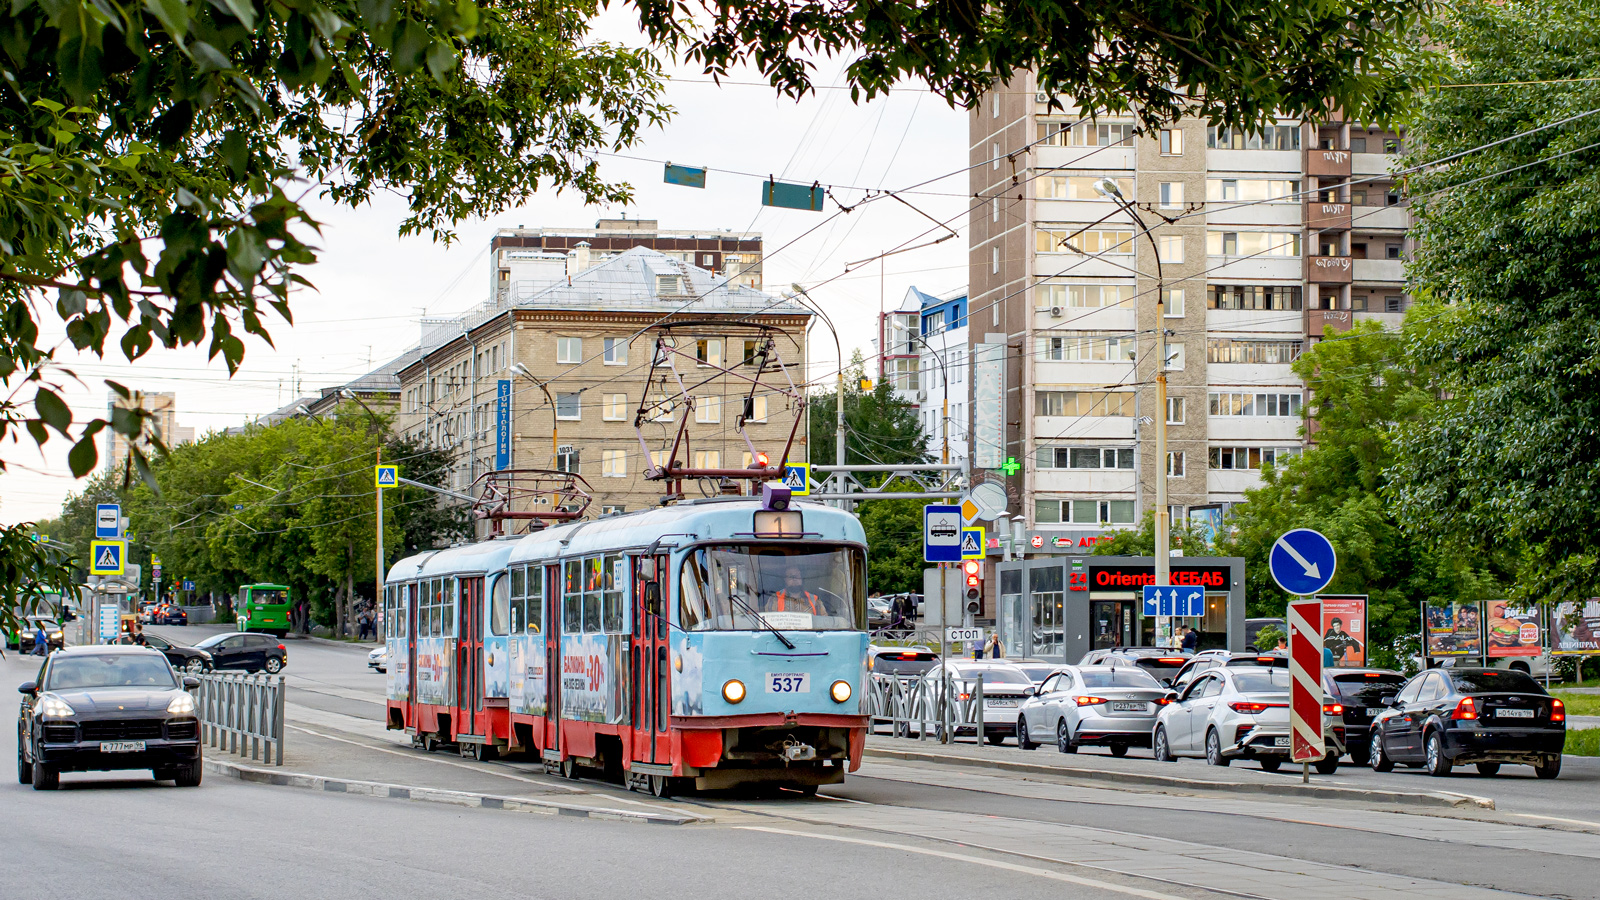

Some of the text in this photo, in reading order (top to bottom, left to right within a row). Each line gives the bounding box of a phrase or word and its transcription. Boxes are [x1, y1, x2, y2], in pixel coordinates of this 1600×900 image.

[559, 446, 573, 454] 1031
[773, 516, 783, 538] 1
[1069, 572, 1087, 584] 24
[1096, 571, 1224, 586] Orienta КЕБАБ
[951, 630, 979, 640] СТОП
[1557, 641, 1600, 650] ЛЕНИНГРАД
[564, 655, 586, 674] БАЛКОНЫ
[586, 654, 605, 692] -30%
[772, 677, 803, 692] 537
